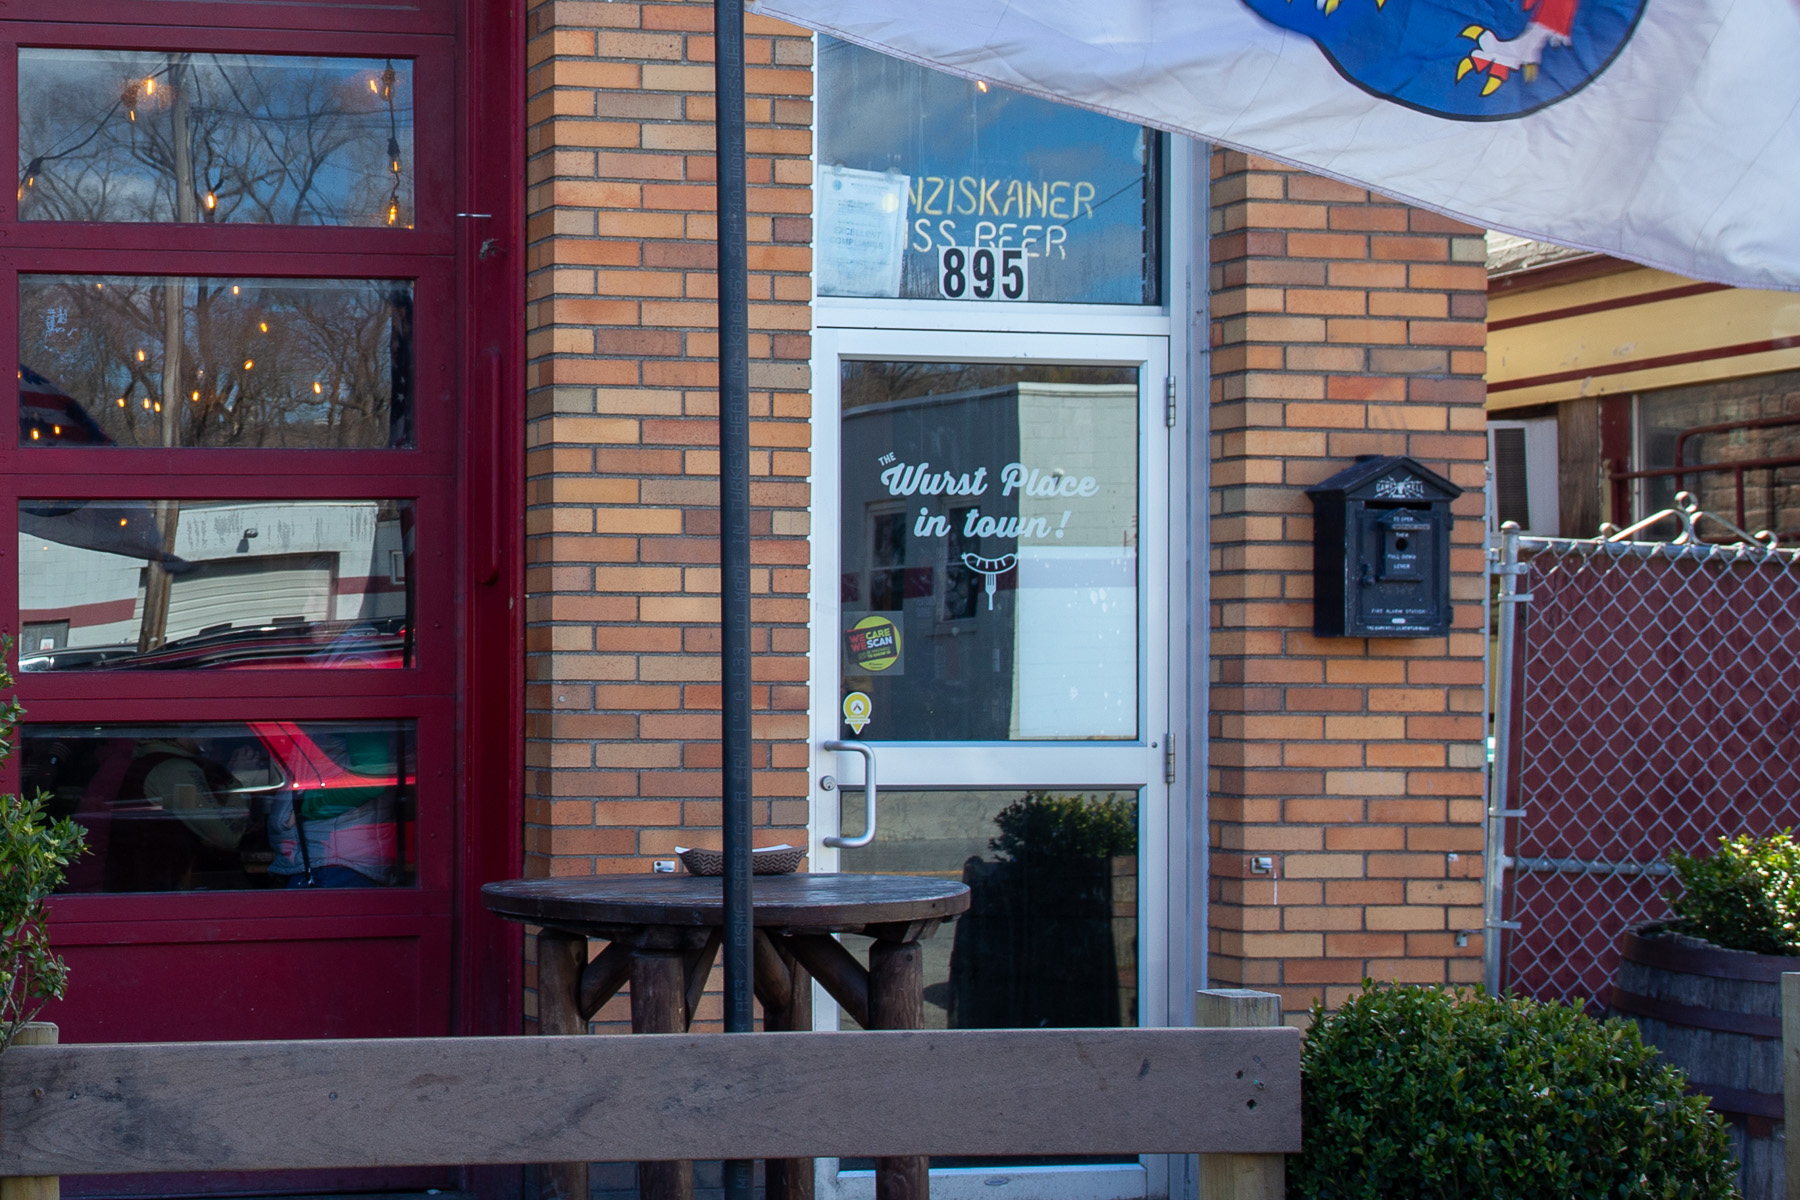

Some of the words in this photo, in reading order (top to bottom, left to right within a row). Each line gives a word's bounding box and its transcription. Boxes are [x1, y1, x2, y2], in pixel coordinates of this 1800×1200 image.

[943, 247, 1024, 300] 895
[729, 390, 743, 435] HEAT
[878, 451, 897, 467] THE
[729, 447, 744, 512] TURKEY
[880, 462, 988, 497] Wurst
[1000, 462, 1100, 497] Place
[732, 524, 746, 544] IN
[913, 507, 952, 538] in
[733, 559, 747, 602] MADE
[848, 633, 866, 644] WE
[865, 627, 891, 640] CARE
[850, 642, 868, 652] WE
[866, 636, 893, 649] SCAN
